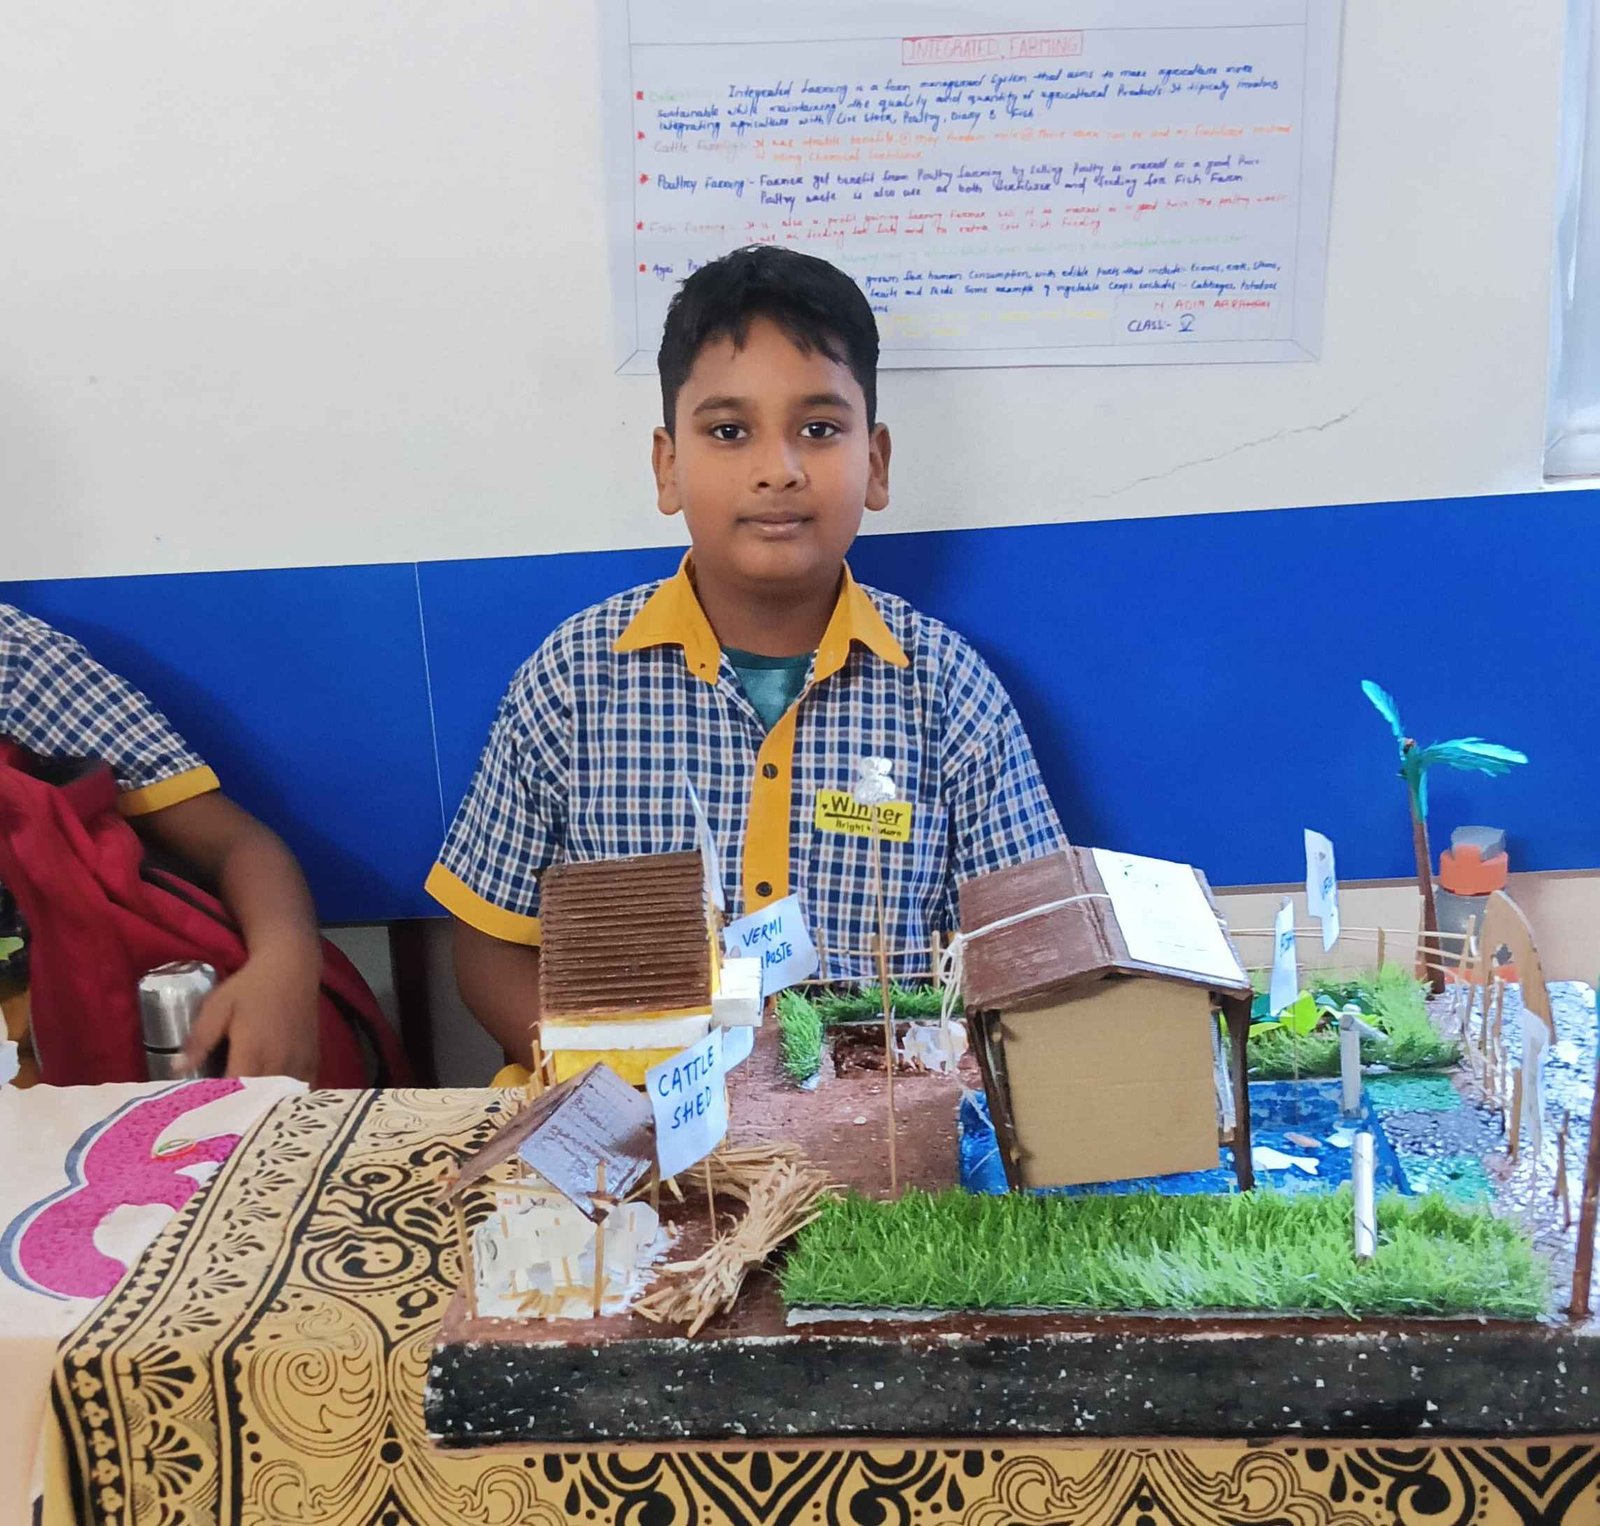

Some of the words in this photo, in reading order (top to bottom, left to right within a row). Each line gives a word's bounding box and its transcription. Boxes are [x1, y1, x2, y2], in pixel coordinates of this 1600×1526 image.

[1009, 33, 1078, 57] FARMING
[1101, 69, 1114, 79] to
[847, 98, 870, 109] the
[1174, 173, 1202, 185] Fish
[836, 818, 864, 833] Bright
[742, 915, 782, 947] VERMI
[761, 941, 793, 969] POSTE
[658, 1045, 714, 1097] CATTLE
[671, 1086, 712, 1129] SHED
